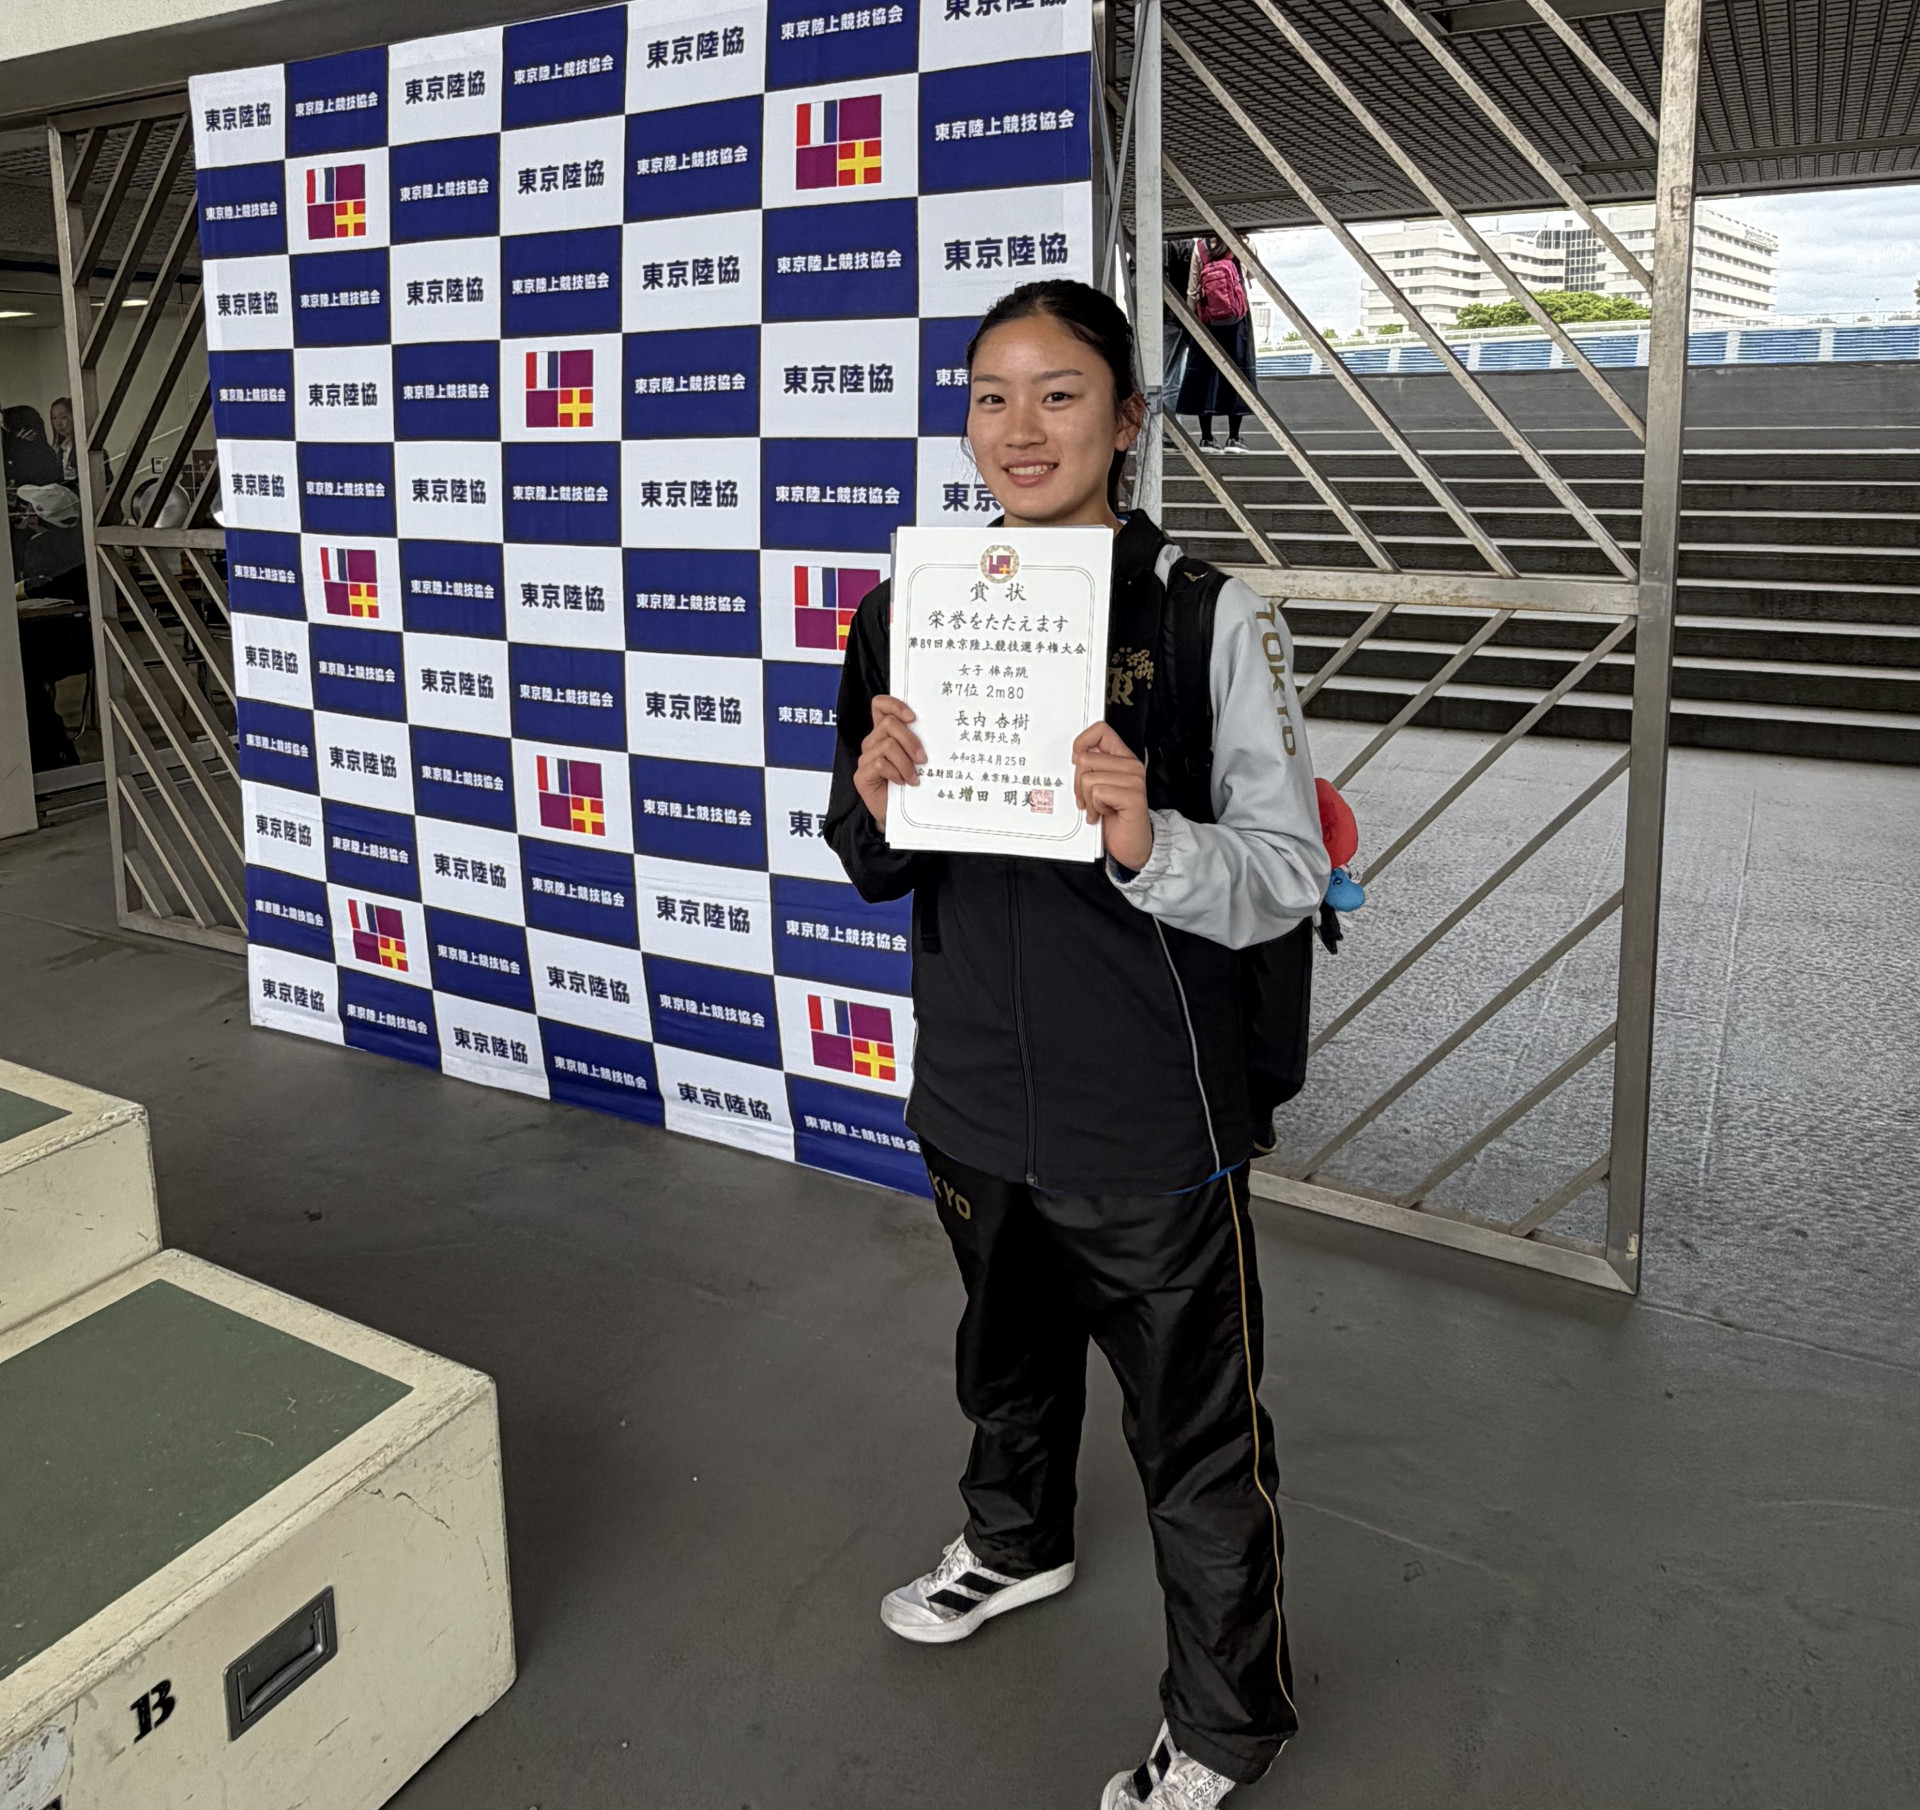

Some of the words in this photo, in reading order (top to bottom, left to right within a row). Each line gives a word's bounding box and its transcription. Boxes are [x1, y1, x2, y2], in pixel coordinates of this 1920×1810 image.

[781, 4, 904, 40] 東京陸上競技協会
[646, 25, 745, 69] 東京陸協
[513, 54, 614, 85] 東京陸上競技協会
[405, 69, 486, 105] 東京陸協
[204, 102, 272, 132] 東京陸協
[295, 91, 378, 117] 東京陸上競技協会
[935, 109, 1075, 142] 東京陸上競技協会
[636, 145, 748, 175] 東京陸上競技協会
[400, 178, 489, 202] 東京陸上競技協会
[517, 159, 605, 195] 東京陸協
[205, 201, 278, 221] 東京陸上競技協会
[776, 249, 902, 274] 東京陸上競技協会
[943, 232, 1068, 271] 東京陸協
[511, 272, 610, 295] 東京陸上競技協会
[642, 254, 740, 290] 東京陸協
[216, 291, 279, 317] 東京陸協
[300, 289, 380, 308] 東京陸上競技協会
[406, 276, 484, 306] 東京陸協
[403, 383, 490, 400] 東京陸上競技協会
[634, 373, 746, 394] 東京陸上競技協会
[783, 363, 894, 395] 東京陸協
[219, 388, 286, 402] 東京陸上競技協会
[308, 382, 378, 407] 東京陸協
[231, 473, 285, 498] 東京陸協
[305, 481, 386, 497] 東京陸上競技協会
[411, 478, 486, 505] 東京陸協
[512, 485, 609, 502] 東京陸上競技協会
[640, 479, 738, 508] 東京陸協
[775, 485, 900, 505] 東京陸上競技協会
[233, 564, 296, 584] 東京陸上競技協会
[410, 579, 495, 599] 東京陸上競技協会
[520, 582, 605, 612] 東京陸協
[636, 593, 746, 613] 東京陸上競技協会
[928, 610, 1069, 633] 栄誉をたたえます
[244, 645, 298, 675] 東京陸協
[908, 637, 1087, 655] 第89回東京陸上競技選手権大会
[318, 660, 396, 683] 東京陸上競技協会
[420, 668, 494, 700] 東京陸協
[958, 664, 984, 678] 女子
[988, 664, 1029, 680] 棒高跳
[519, 684, 614, 708] 東京陸上競技協会
[941, 681, 979, 697] 第7位
[986, 684, 1025, 700] 2m80
[645, 691, 742, 725] 東京陸協
[954, 710, 986, 728] 長内
[994, 713, 1031, 731] 杏樹
[245, 733, 309, 758] 東京陸上競技協会
[959, 730, 1022, 745] 武蔵野北高
[329, 746, 397, 779] 東京陸協
[949, 751, 1027, 767] 令和8年4月25日
[421, 765, 504, 792] 東京陸上競技協会
[980, 772, 1065, 788] 東京陸上競技協会
[958, 786, 990, 803] 増田
[643, 798, 752, 826] 東京陸上競技協会
[255, 814, 312, 847] 東京陸協
[332, 836, 409, 864] 東京陸上競技協会
[433, 853, 507, 889] 東京陸協
[531, 877, 625, 908] 東京陸上競技協会
[255, 898, 325, 929] 東京陸上競技協会
[655, 895, 750, 934] 東京陸協
[785, 919, 907, 953] 東京陸上競技協会
[437, 944, 521, 975] 東京陸上競技協会
[262, 978, 325, 1013] 東京陸協
[546, 966, 630, 1005] 東京陸協
[346, 1003, 428, 1036] 東京陸上競技協会
[659, 994, 765, 1028] 東京陸上競技協会
[453, 1027, 529, 1065] 東京陸協
[554, 1056, 647, 1090] 東京陸上競技協会
[677, 1082, 772, 1122] 東京陸協
[804, 1115, 921, 1154] 東京陸上競技協会
[130, 1679, 177, 1744] B
